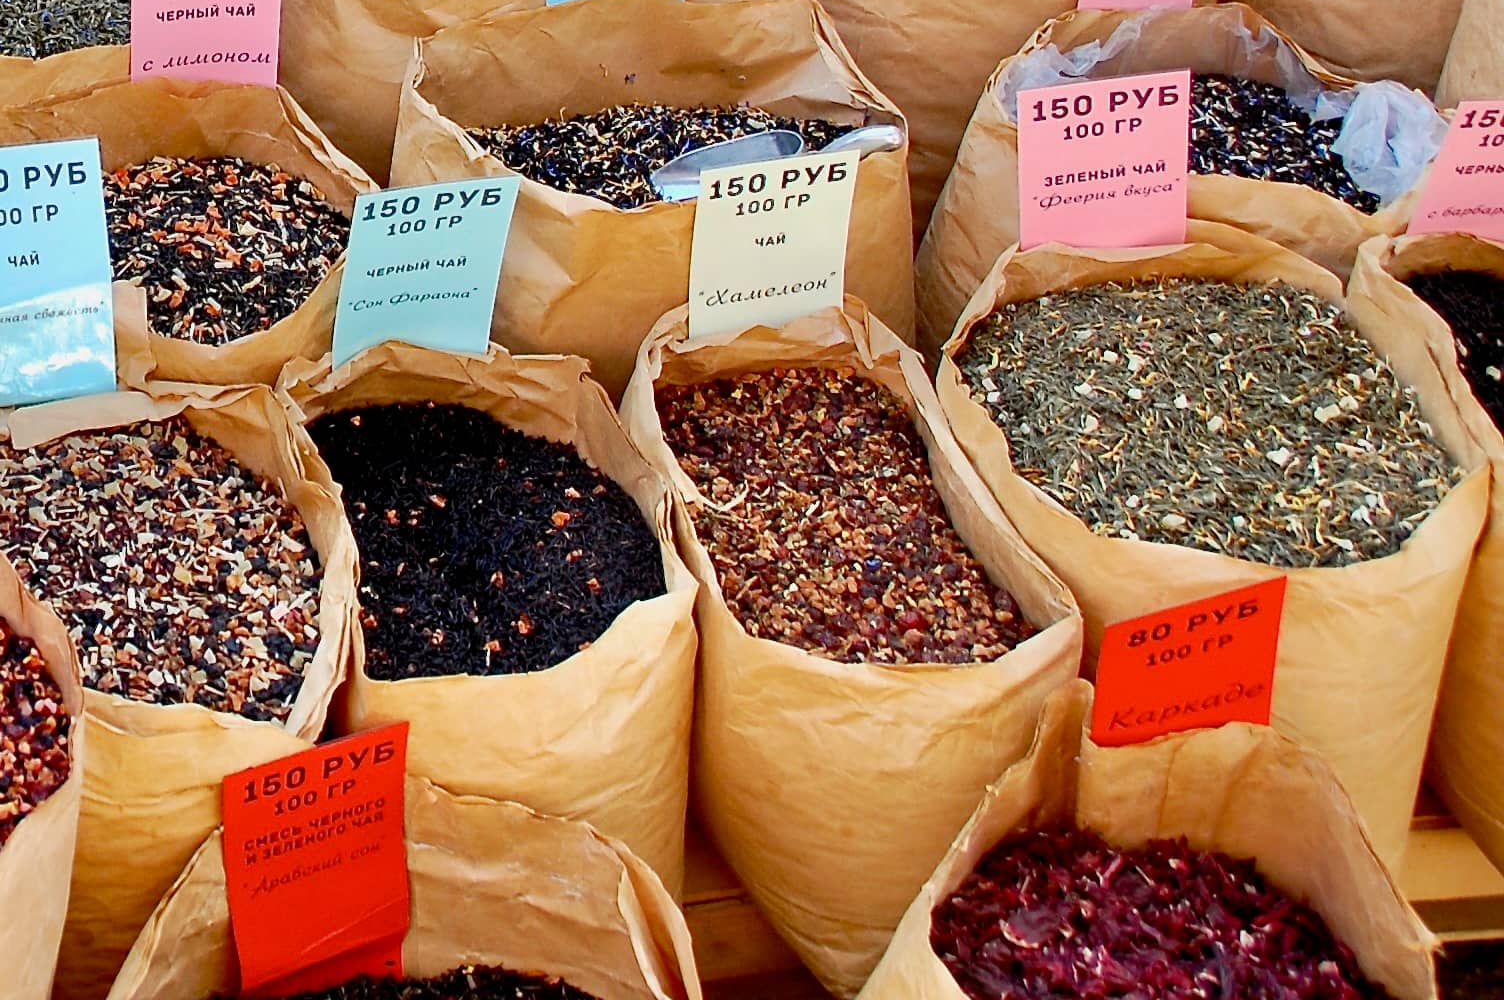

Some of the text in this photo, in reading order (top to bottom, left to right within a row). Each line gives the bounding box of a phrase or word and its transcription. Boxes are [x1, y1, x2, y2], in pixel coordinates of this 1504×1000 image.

[156, 3, 256, 22] ЧЕРНЫЙ ЧАЙ
[142, 52, 270, 72] с лимоном
[23, 161, 87, 190] РУБ
[735, 193, 811, 216] 100 ГР
[386, 215, 463, 237] 100 ГР
[698, 271, 837, 308] "Хамелеон"
[1127, 599, 1259, 648] 80 РУБ
[1108, 682, 1266, 733] Каркаде
[242, 740, 395, 804] 150 РУБ
